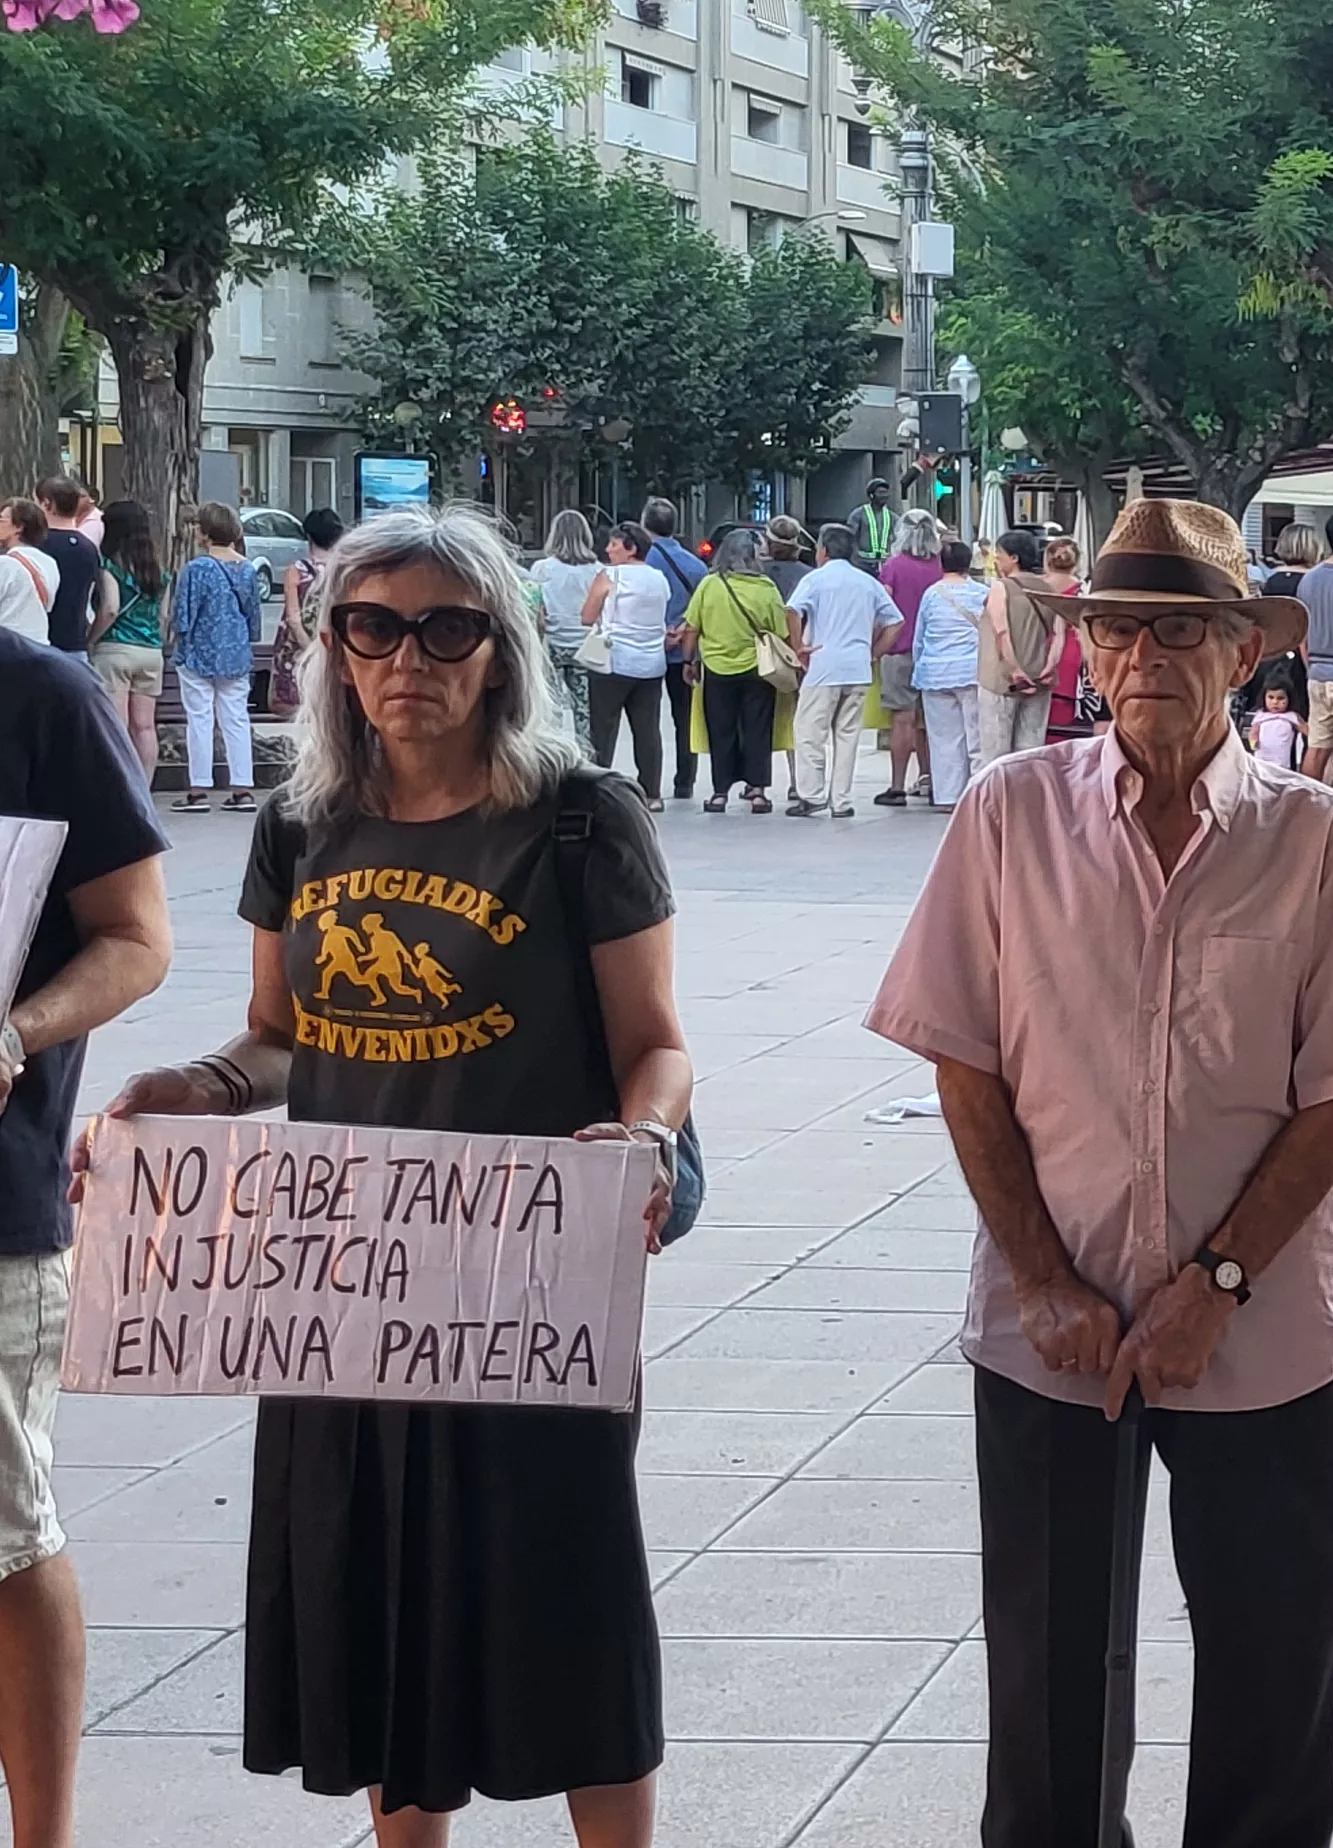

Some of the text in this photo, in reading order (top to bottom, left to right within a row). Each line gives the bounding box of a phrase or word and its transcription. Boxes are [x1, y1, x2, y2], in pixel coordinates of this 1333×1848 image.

[128, 1146, 564, 1234] NO CABE TANTA
[122, 1232, 410, 1302] INJUSTICIA
[113, 1314, 598, 1387] EN UNA PATERA
